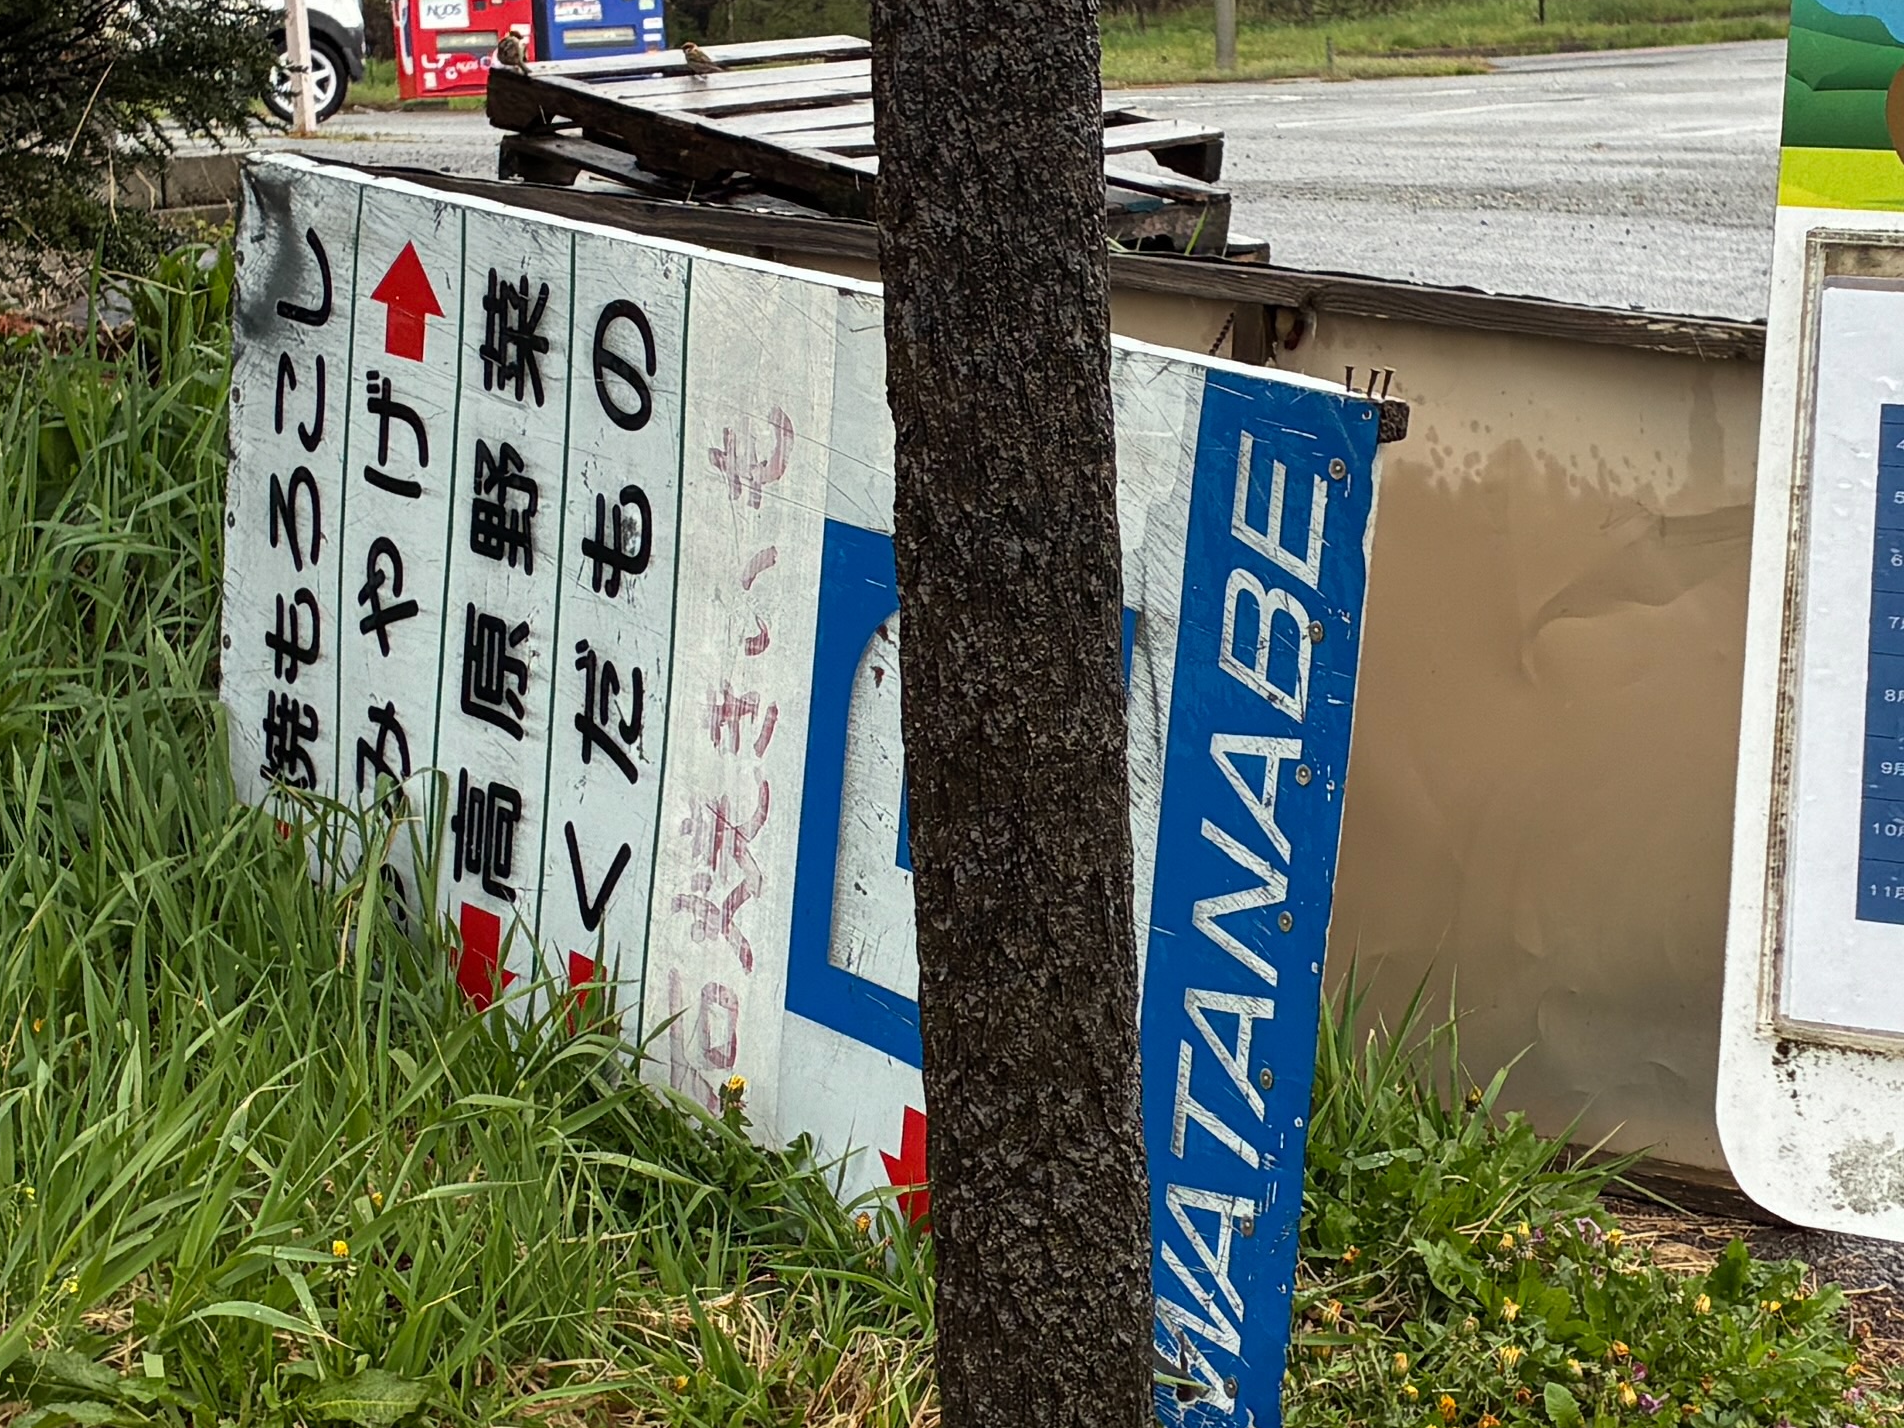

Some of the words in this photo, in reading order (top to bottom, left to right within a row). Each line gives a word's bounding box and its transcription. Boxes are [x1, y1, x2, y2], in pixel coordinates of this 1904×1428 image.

[259, 227, 333, 800] 焼もろこし
[354, 369, 430, 924] みやげ
[450, 267, 551, 904] 高原野菜
[563, 297, 659, 933] くだもの
[1154, 428, 1329, 1416] WATANABE
